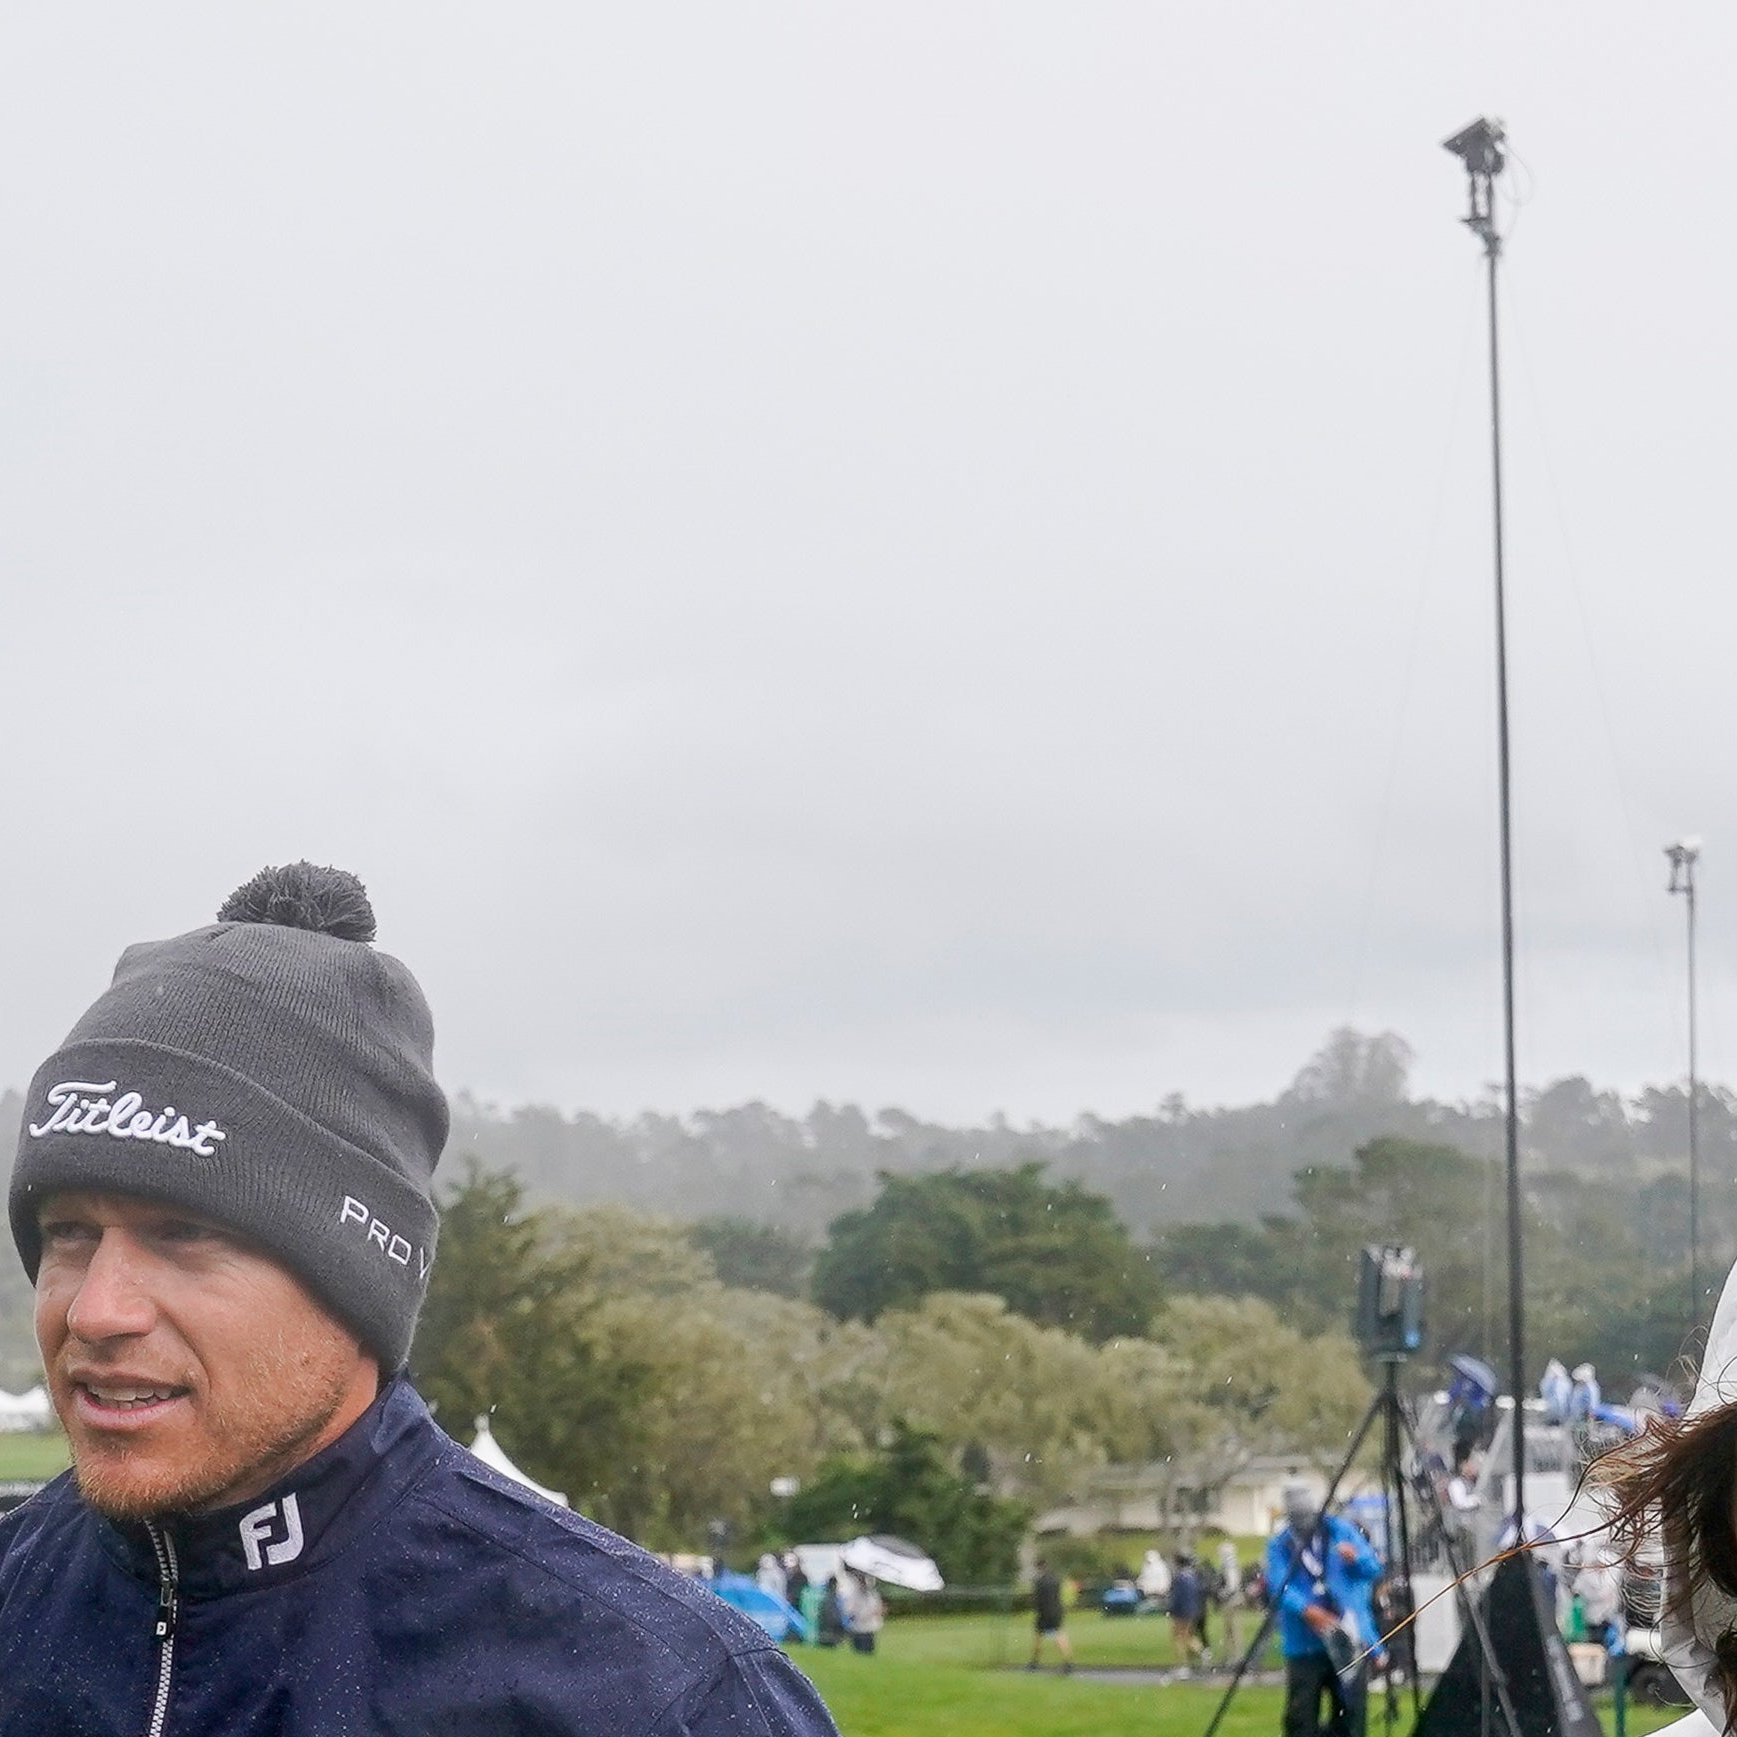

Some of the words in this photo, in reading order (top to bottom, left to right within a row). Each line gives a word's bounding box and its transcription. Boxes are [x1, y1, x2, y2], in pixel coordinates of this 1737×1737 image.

[30, 1080, 226, 1157] Titleist
[339, 1195, 413, 1267] PRO
[239, 1492, 304, 1570] FJ
